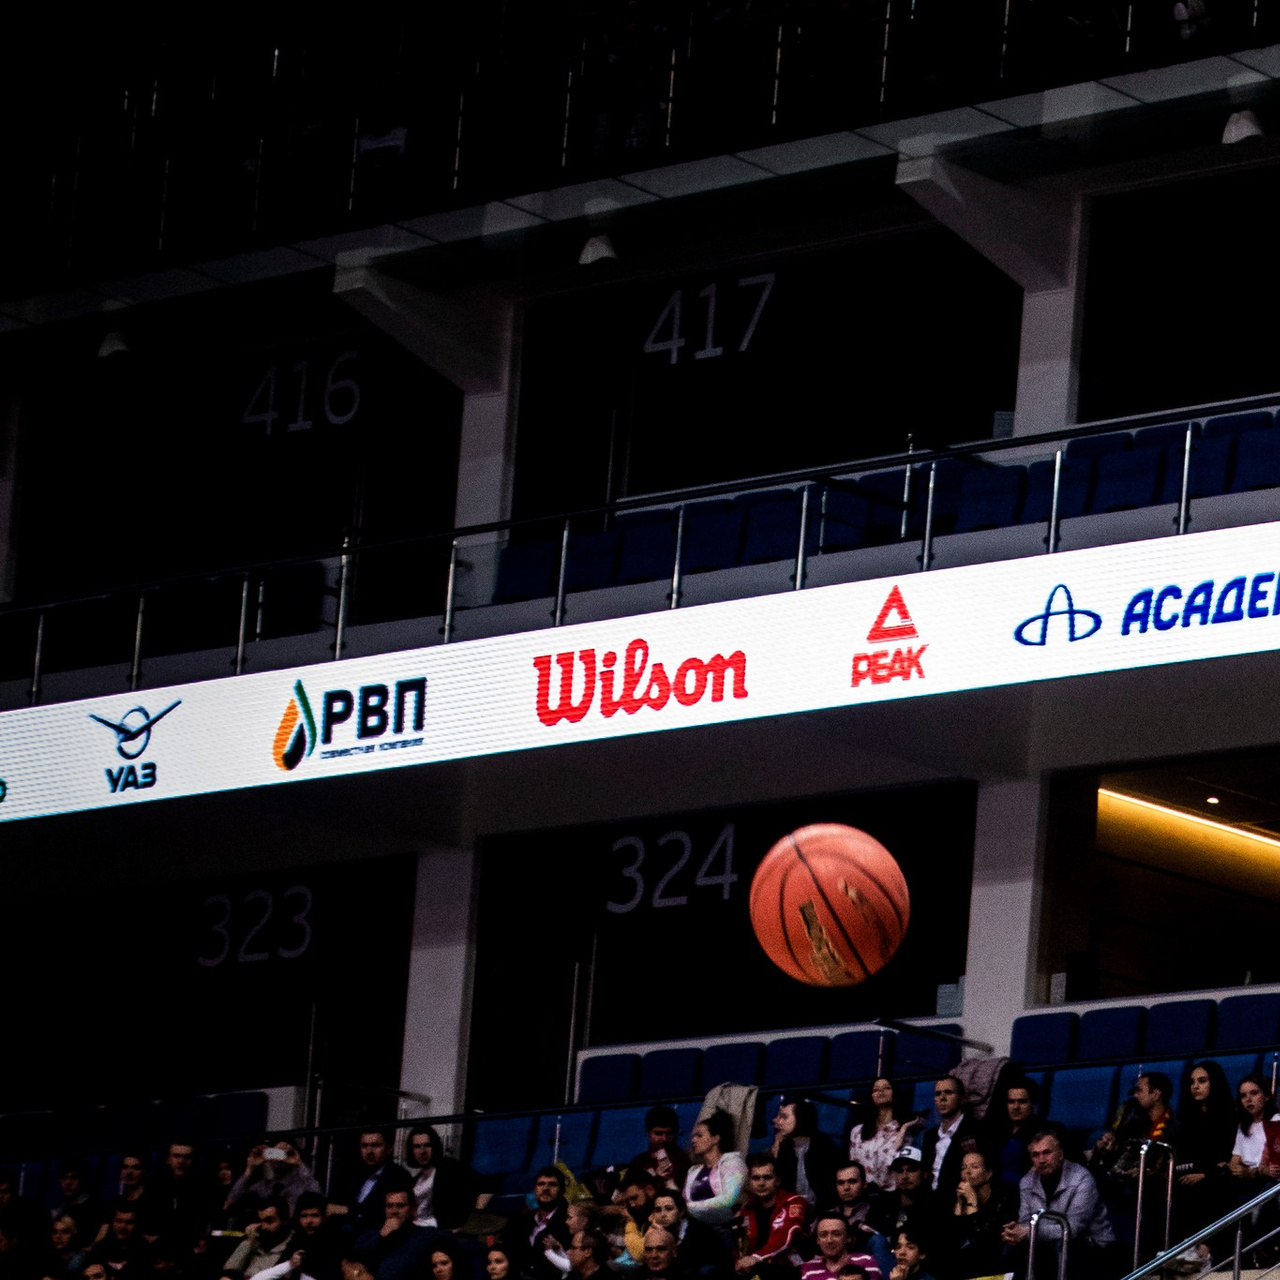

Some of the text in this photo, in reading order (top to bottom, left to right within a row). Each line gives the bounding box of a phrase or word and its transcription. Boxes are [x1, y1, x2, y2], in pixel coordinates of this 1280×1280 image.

[643, 273, 776, 364] 417
[242, 351, 361, 436] 416
[533, 638, 749, 727] Wilson
[852, 644, 929, 688] PEAK
[321, 677, 428, 746] РВП
[105, 761, 157, 793] УАЗ
[605, 823, 739, 915] 324
[196, 884, 314, 970] 323
